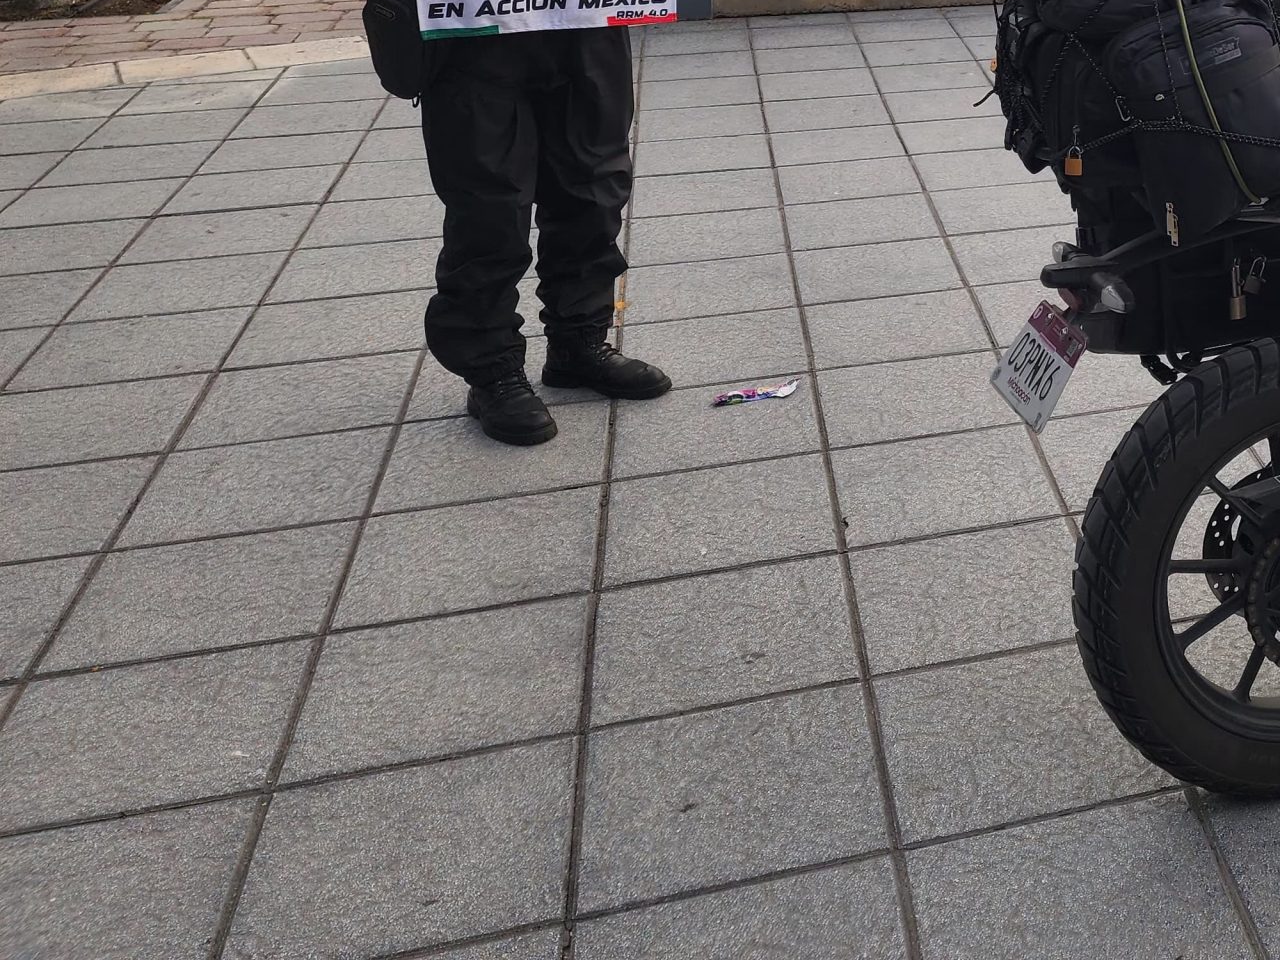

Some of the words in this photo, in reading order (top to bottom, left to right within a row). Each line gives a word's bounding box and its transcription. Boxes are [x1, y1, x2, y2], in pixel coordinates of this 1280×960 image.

[427, 3, 464, 19] EN
[616, 10, 644, 19] RRM
[648, 8, 668, 17] 4.0
